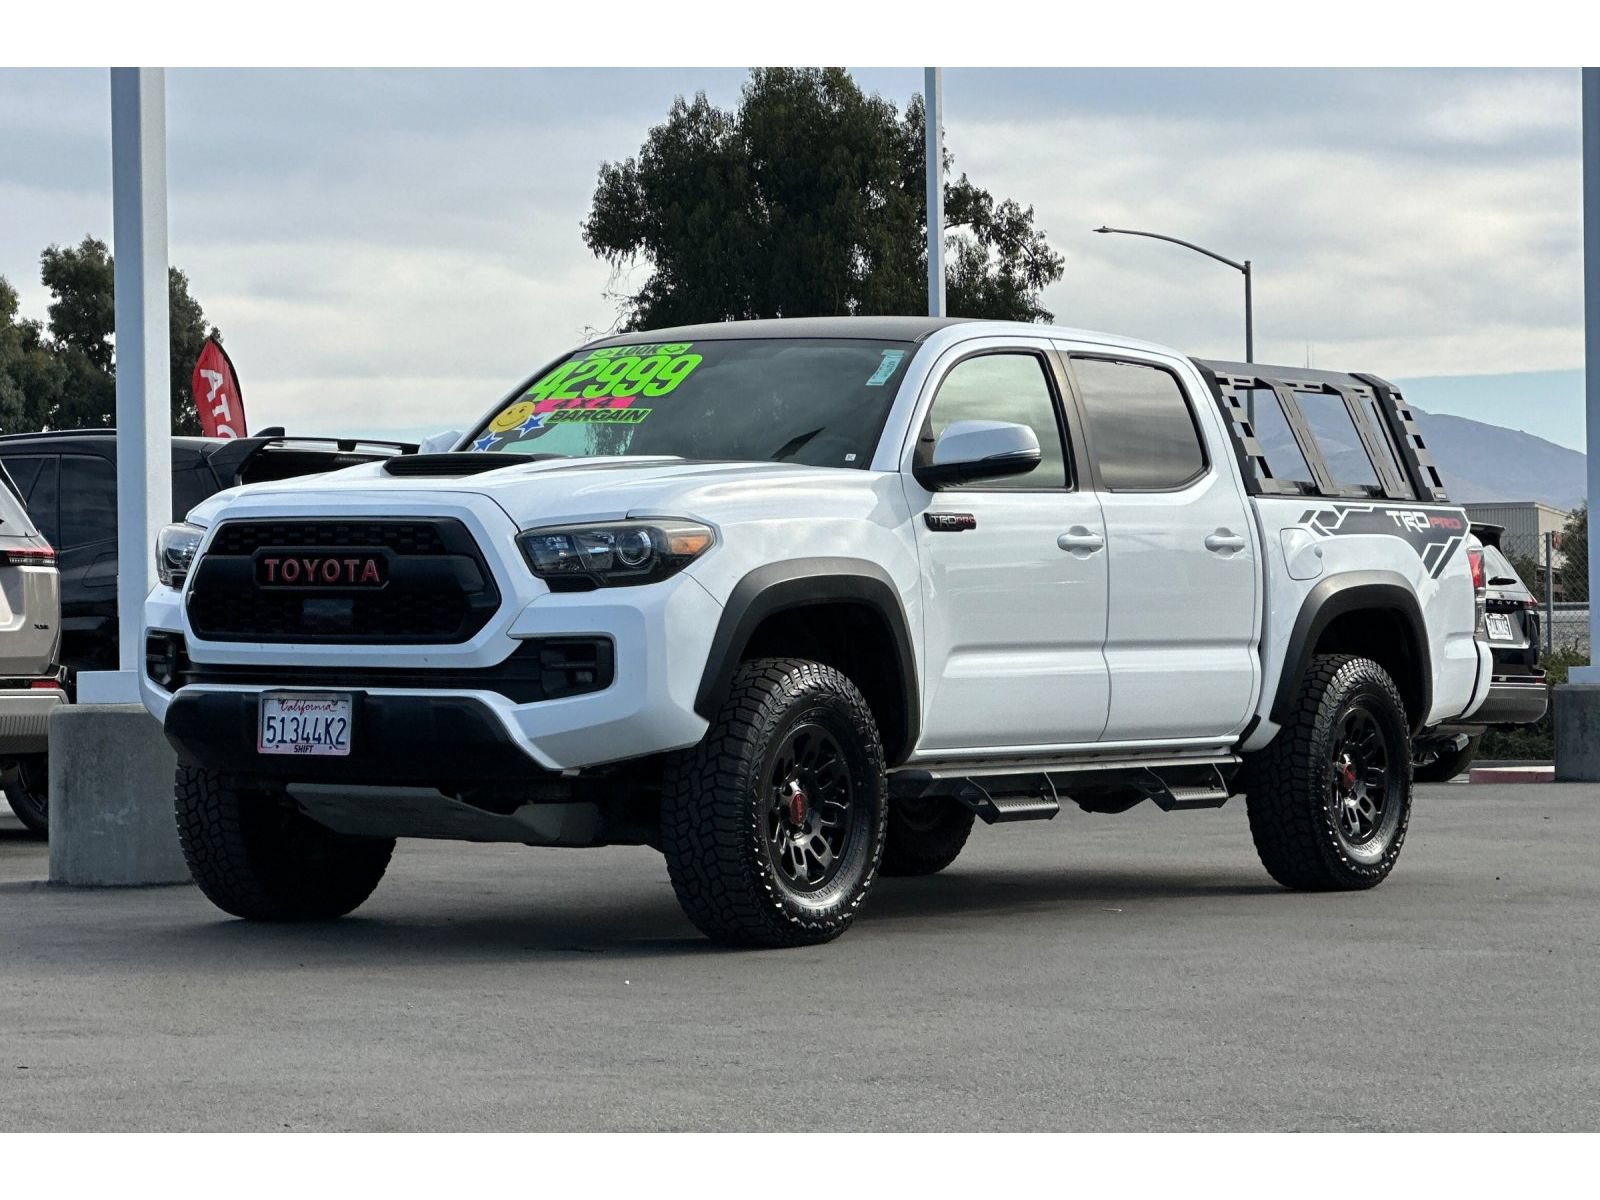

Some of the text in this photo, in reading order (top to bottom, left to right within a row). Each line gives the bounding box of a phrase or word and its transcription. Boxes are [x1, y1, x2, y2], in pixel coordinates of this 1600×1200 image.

[528, 354, 702, 401] 42999
[548, 409, 649, 421] BARGAIN
[930, 515, 956, 528] TRD
[1385, 510, 1462, 533] TRD PRO
[264, 559, 380, 582] TOYOTA
[279, 699, 338, 715] California
[266, 716, 347, 745] 51344K2
[293, 745, 314, 753] SHIFT
